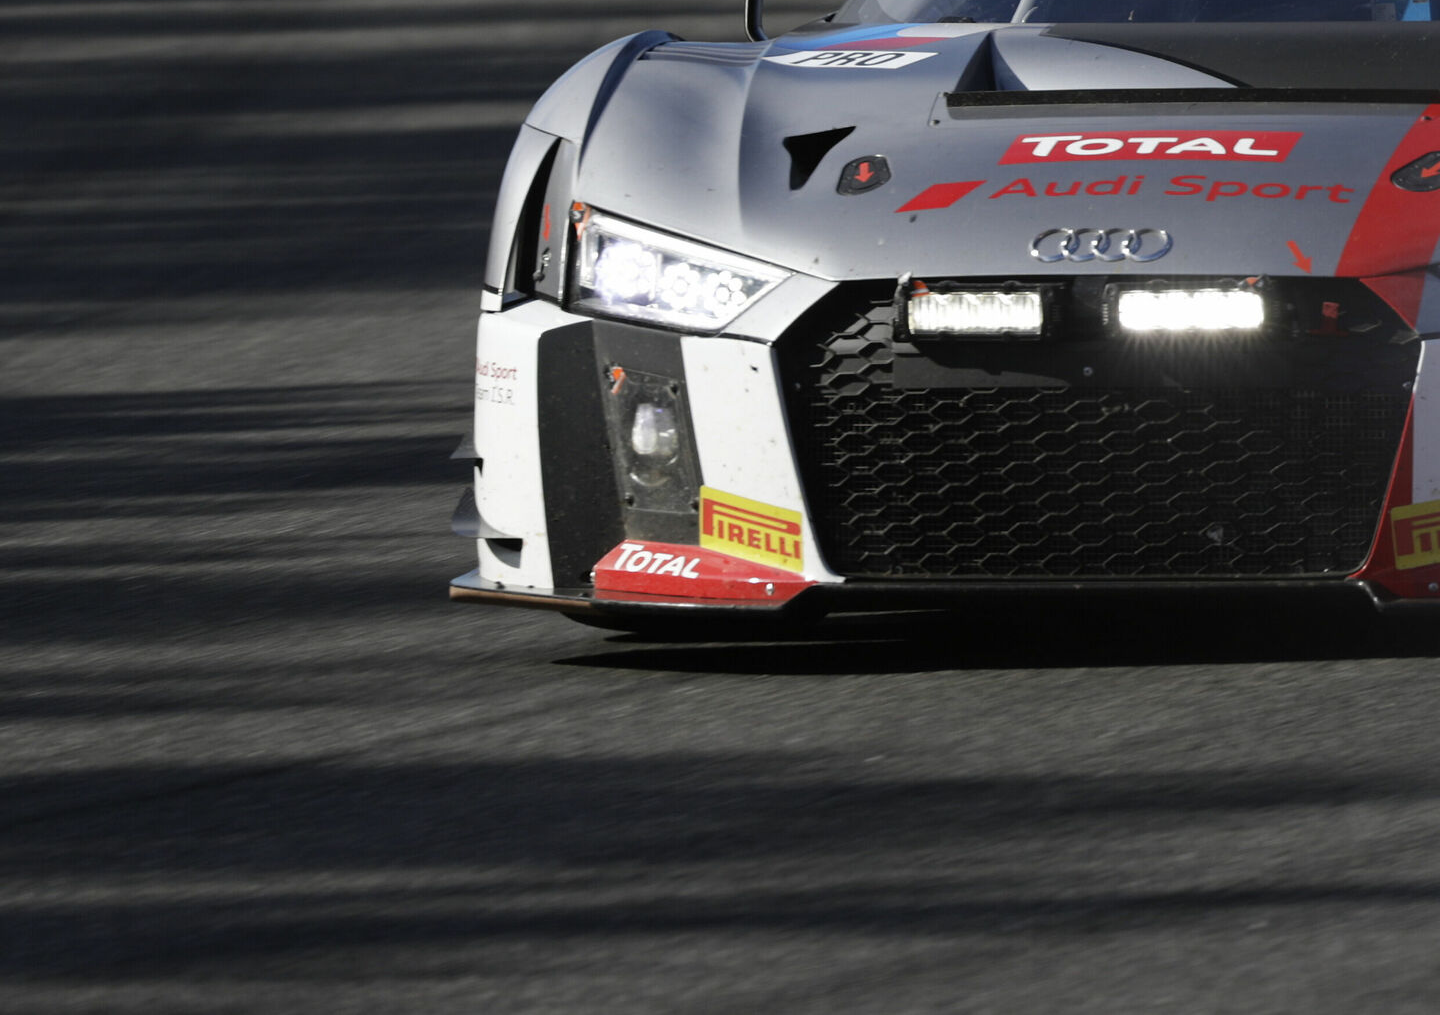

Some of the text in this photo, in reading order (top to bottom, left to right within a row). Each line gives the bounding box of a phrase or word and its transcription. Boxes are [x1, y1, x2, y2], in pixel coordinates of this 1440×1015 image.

[794, 51, 904, 67] PRO
[1022, 135, 1280, 157] TOTAL
[987, 175, 1356, 203] Audi Sport
[702, 498, 801, 560] PIRELLI
[613, 543, 701, 579] TOTAL
